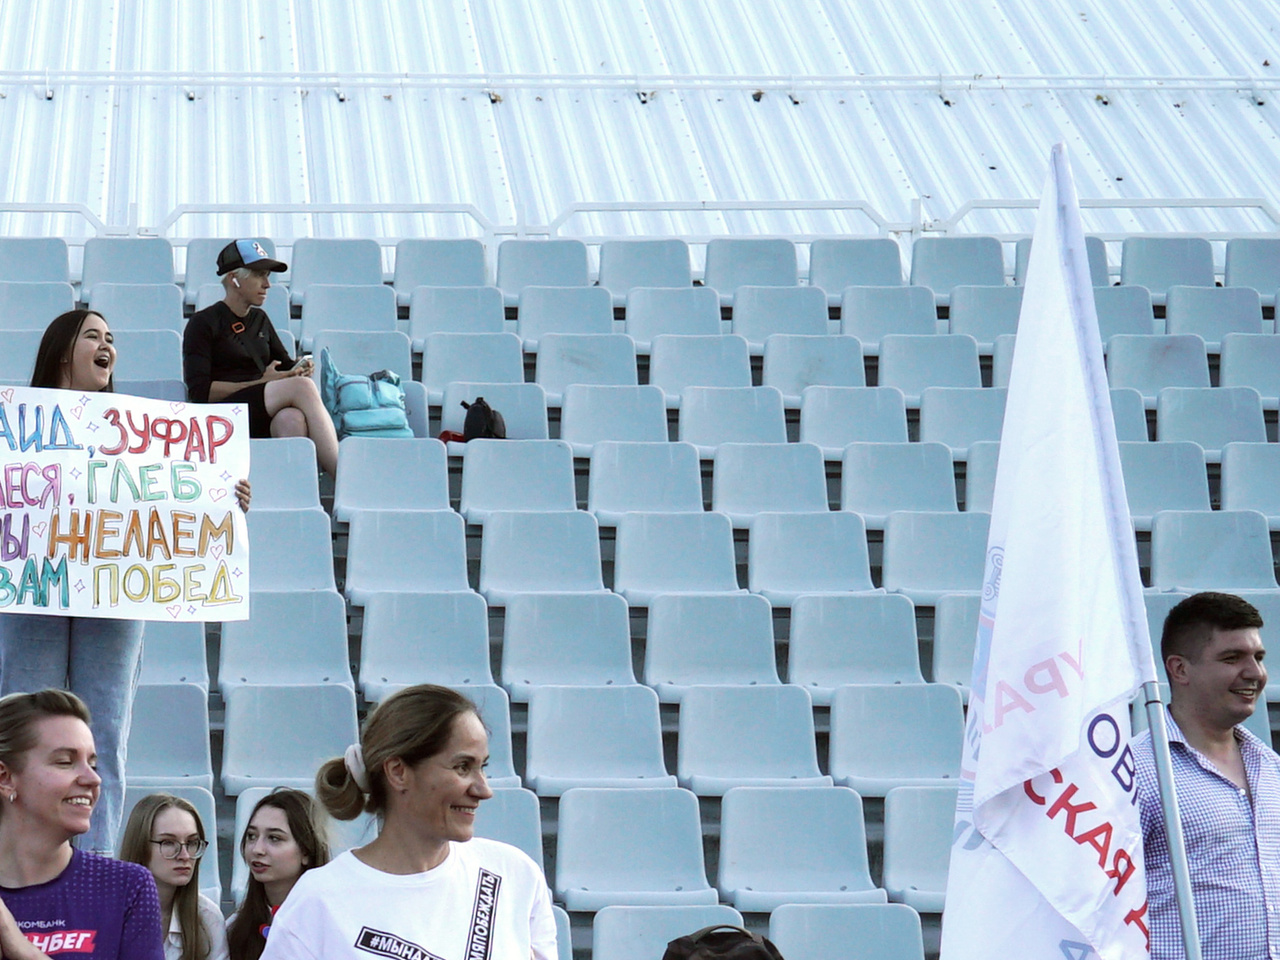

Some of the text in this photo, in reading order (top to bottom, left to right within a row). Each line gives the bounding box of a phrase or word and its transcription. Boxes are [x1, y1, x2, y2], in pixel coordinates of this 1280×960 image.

[98, 407, 234, 464] ЗУФАР
[87, 459, 202, 505] ГЛЕБ
[47, 505, 233, 565] ЖЕЛАЕМ
[92, 560, 243, 609] ПОБЕД
[16, 919, 66, 928] КОМБАНК
